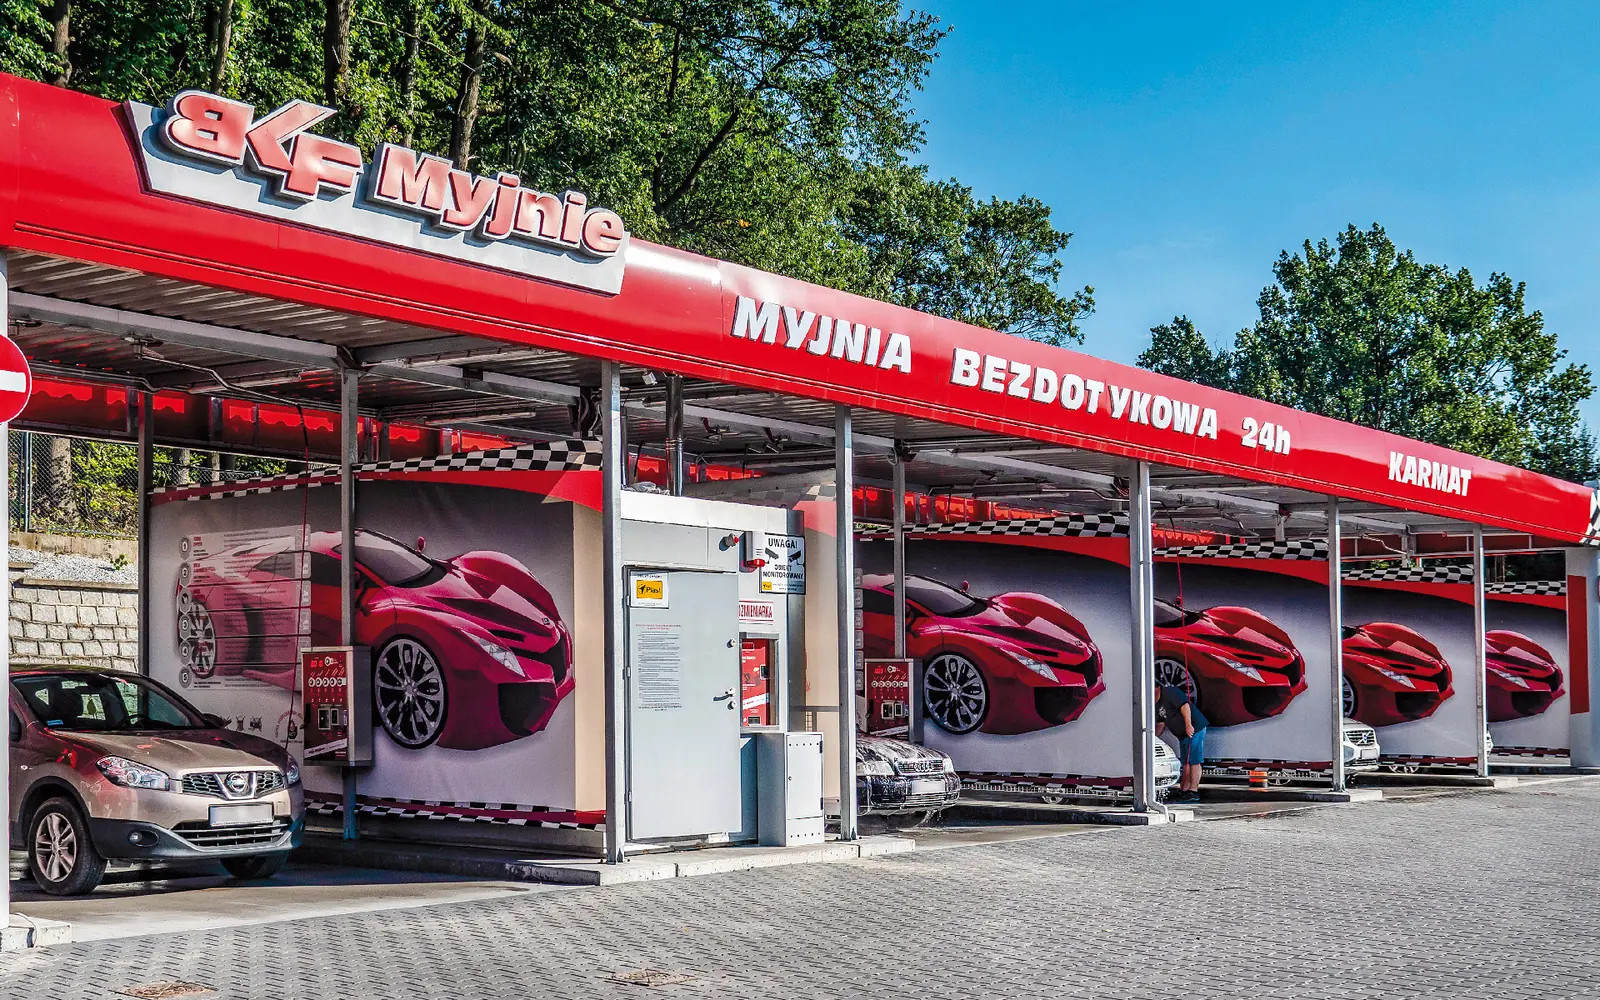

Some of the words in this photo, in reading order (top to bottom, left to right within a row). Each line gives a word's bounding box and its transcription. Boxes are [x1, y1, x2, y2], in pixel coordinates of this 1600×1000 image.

[373, 142, 624, 257] Myjnie
[731, 295, 912, 374] MYJNIA
[1241, 417, 1292, 456] 24h
[1388, 451, 1472, 497] KARMAT
[762, 571, 804, 580] MONITOROWANY
[774, 563, 792, 572] OBIEKT
[738, 604, 773, 618] ZMIENIARKA
